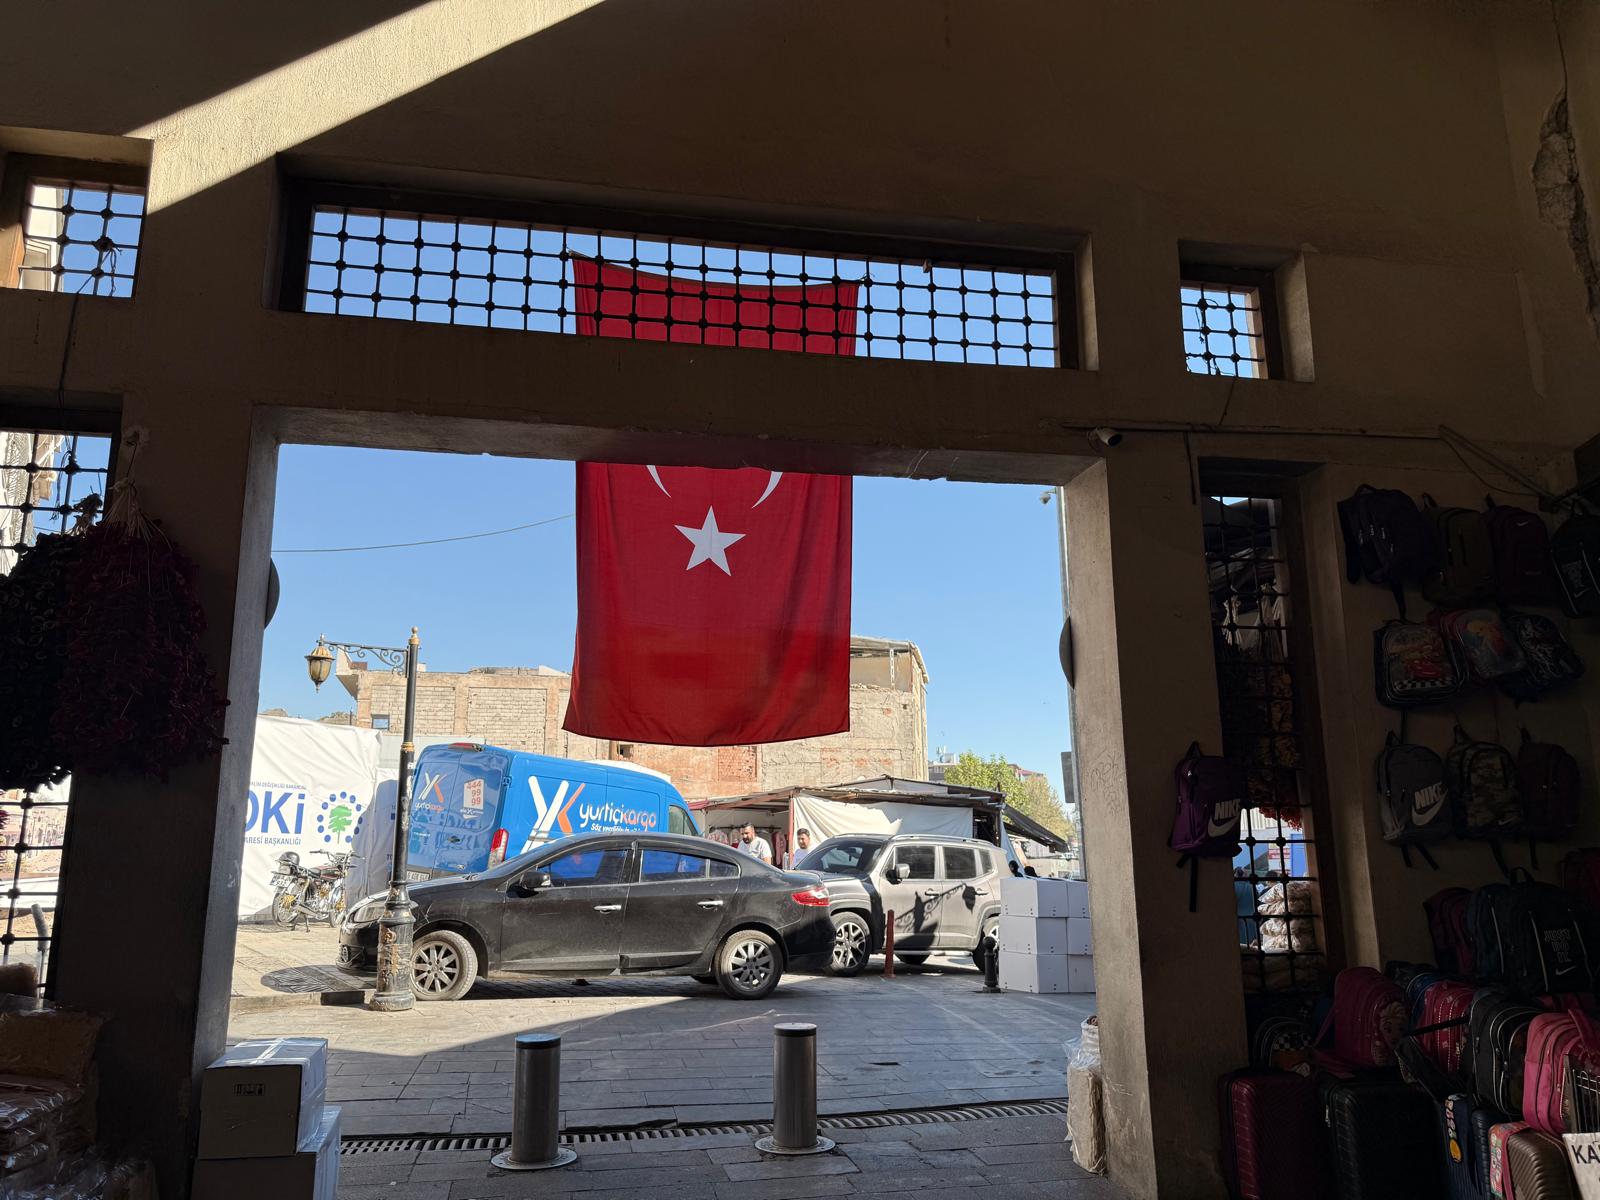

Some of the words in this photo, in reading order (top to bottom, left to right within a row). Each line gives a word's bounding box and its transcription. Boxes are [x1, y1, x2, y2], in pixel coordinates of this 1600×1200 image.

[471, 789, 482, 798] 99
[1415, 782, 1447, 810] NIKE
[471, 797, 482, 806] 99
[264, 837, 301, 847] BAŞKANLIĞI
